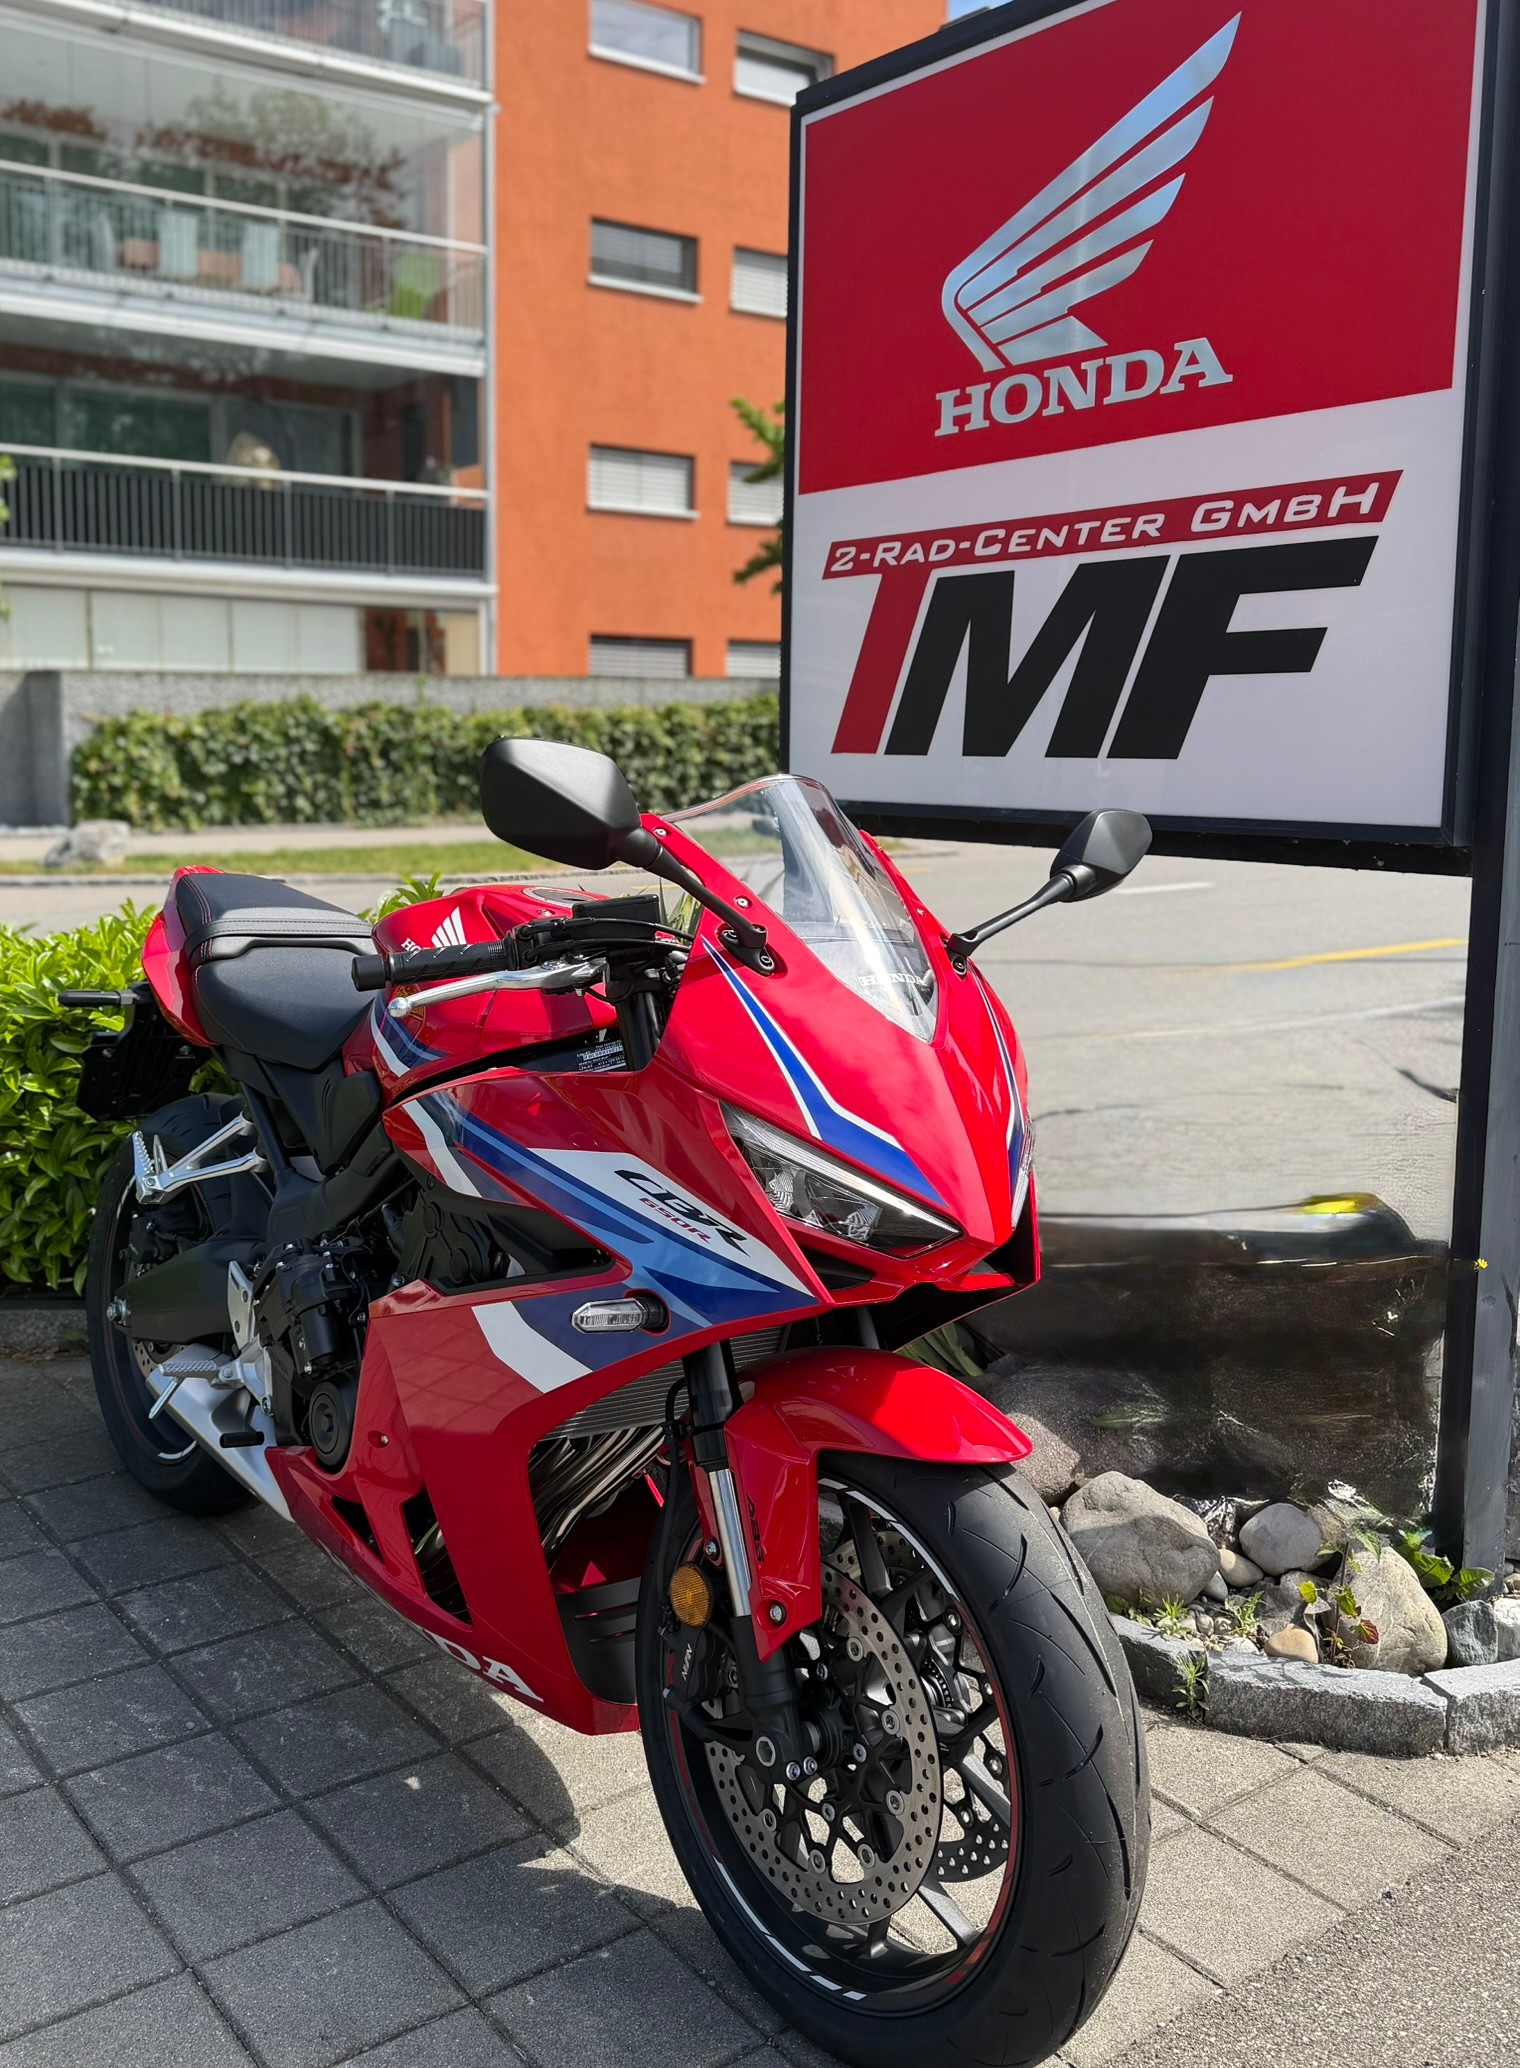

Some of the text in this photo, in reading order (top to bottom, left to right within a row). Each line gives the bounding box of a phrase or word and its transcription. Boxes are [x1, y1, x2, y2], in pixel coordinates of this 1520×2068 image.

[935, 337, 1233, 437] HONDA
[828, 535, 1379, 759] TMF
[614, 1170, 751, 1257] CBR
[639, 1198, 712, 1244] 650R
